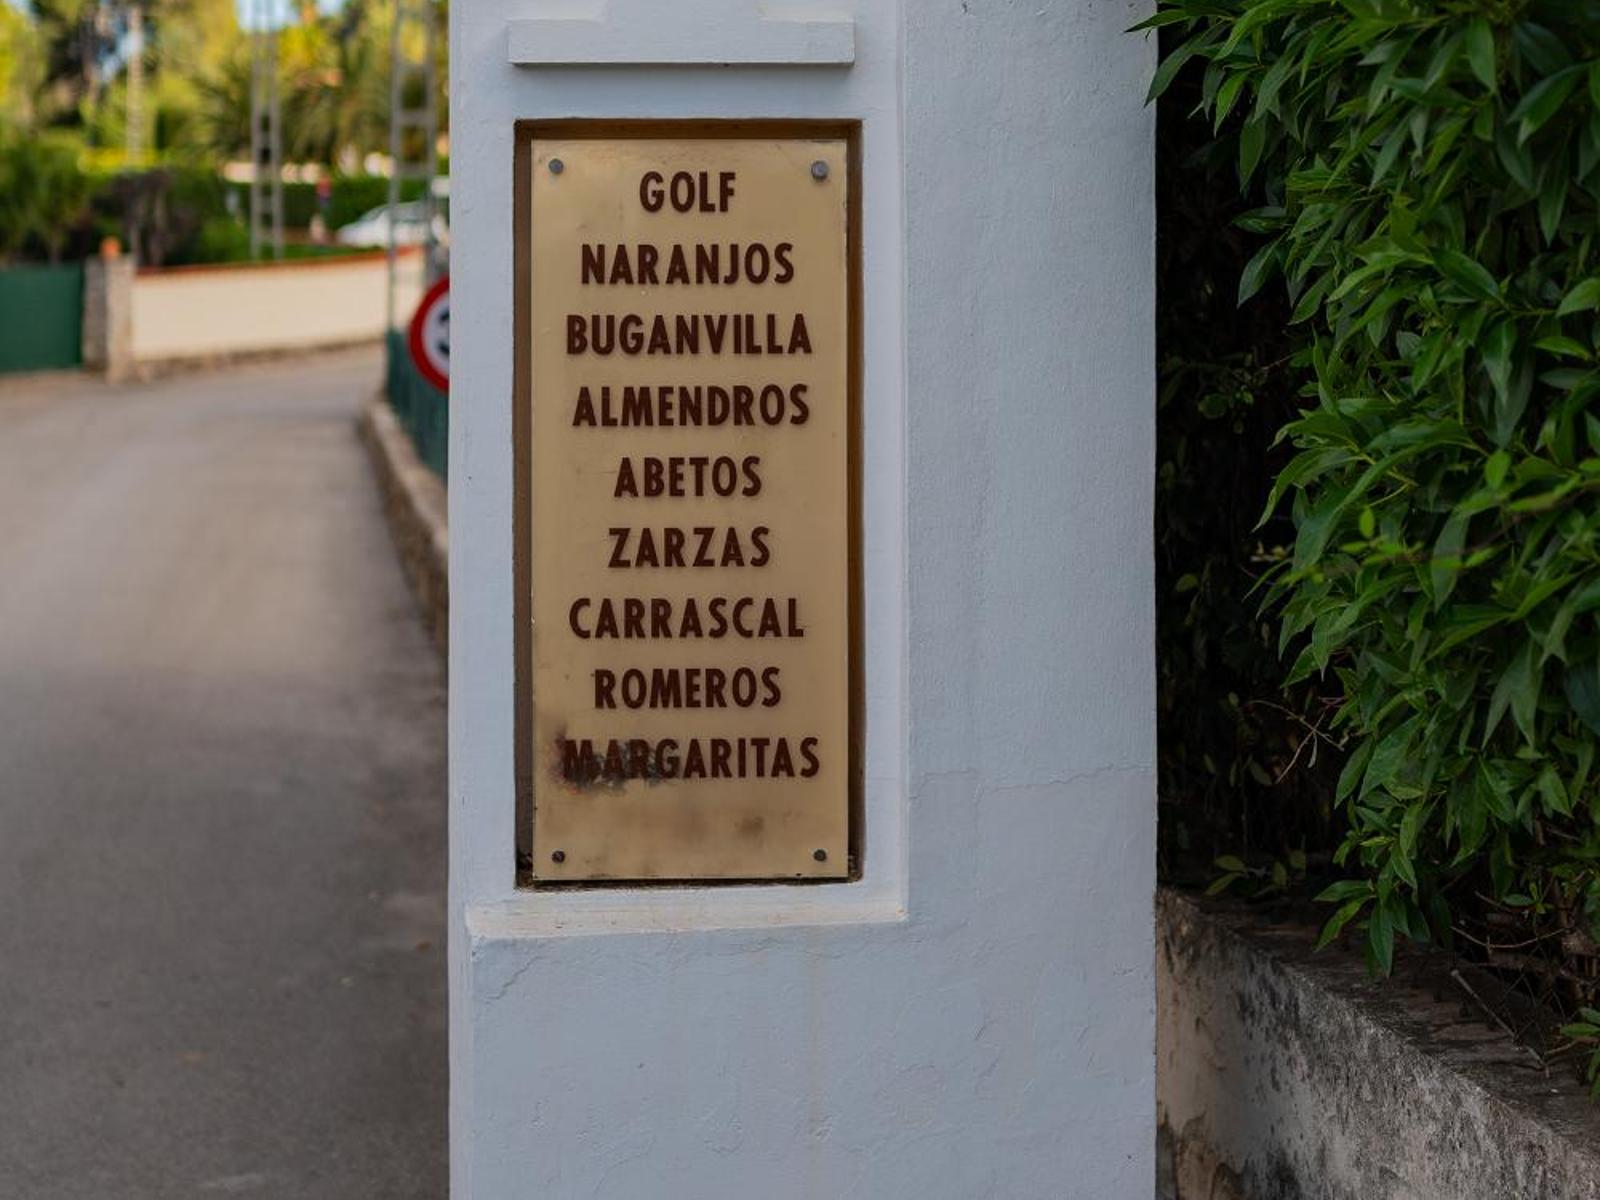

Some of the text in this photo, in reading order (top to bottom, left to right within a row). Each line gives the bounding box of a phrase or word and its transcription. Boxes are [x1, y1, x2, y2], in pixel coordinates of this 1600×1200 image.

[639, 171, 736, 213] GOLF
[580, 243, 795, 285] NARANJOS
[566, 313, 813, 356] BUGANVILLA
[572, 384, 810, 427] ALMENDROS
[613, 456, 762, 498] ABETOS
[608, 526, 770, 568] ZARZAS
[568, 597, 804, 639] CARRASCAL
[594, 666, 782, 709] ROMEROS
[561, 737, 820, 780] MARGARITAS
